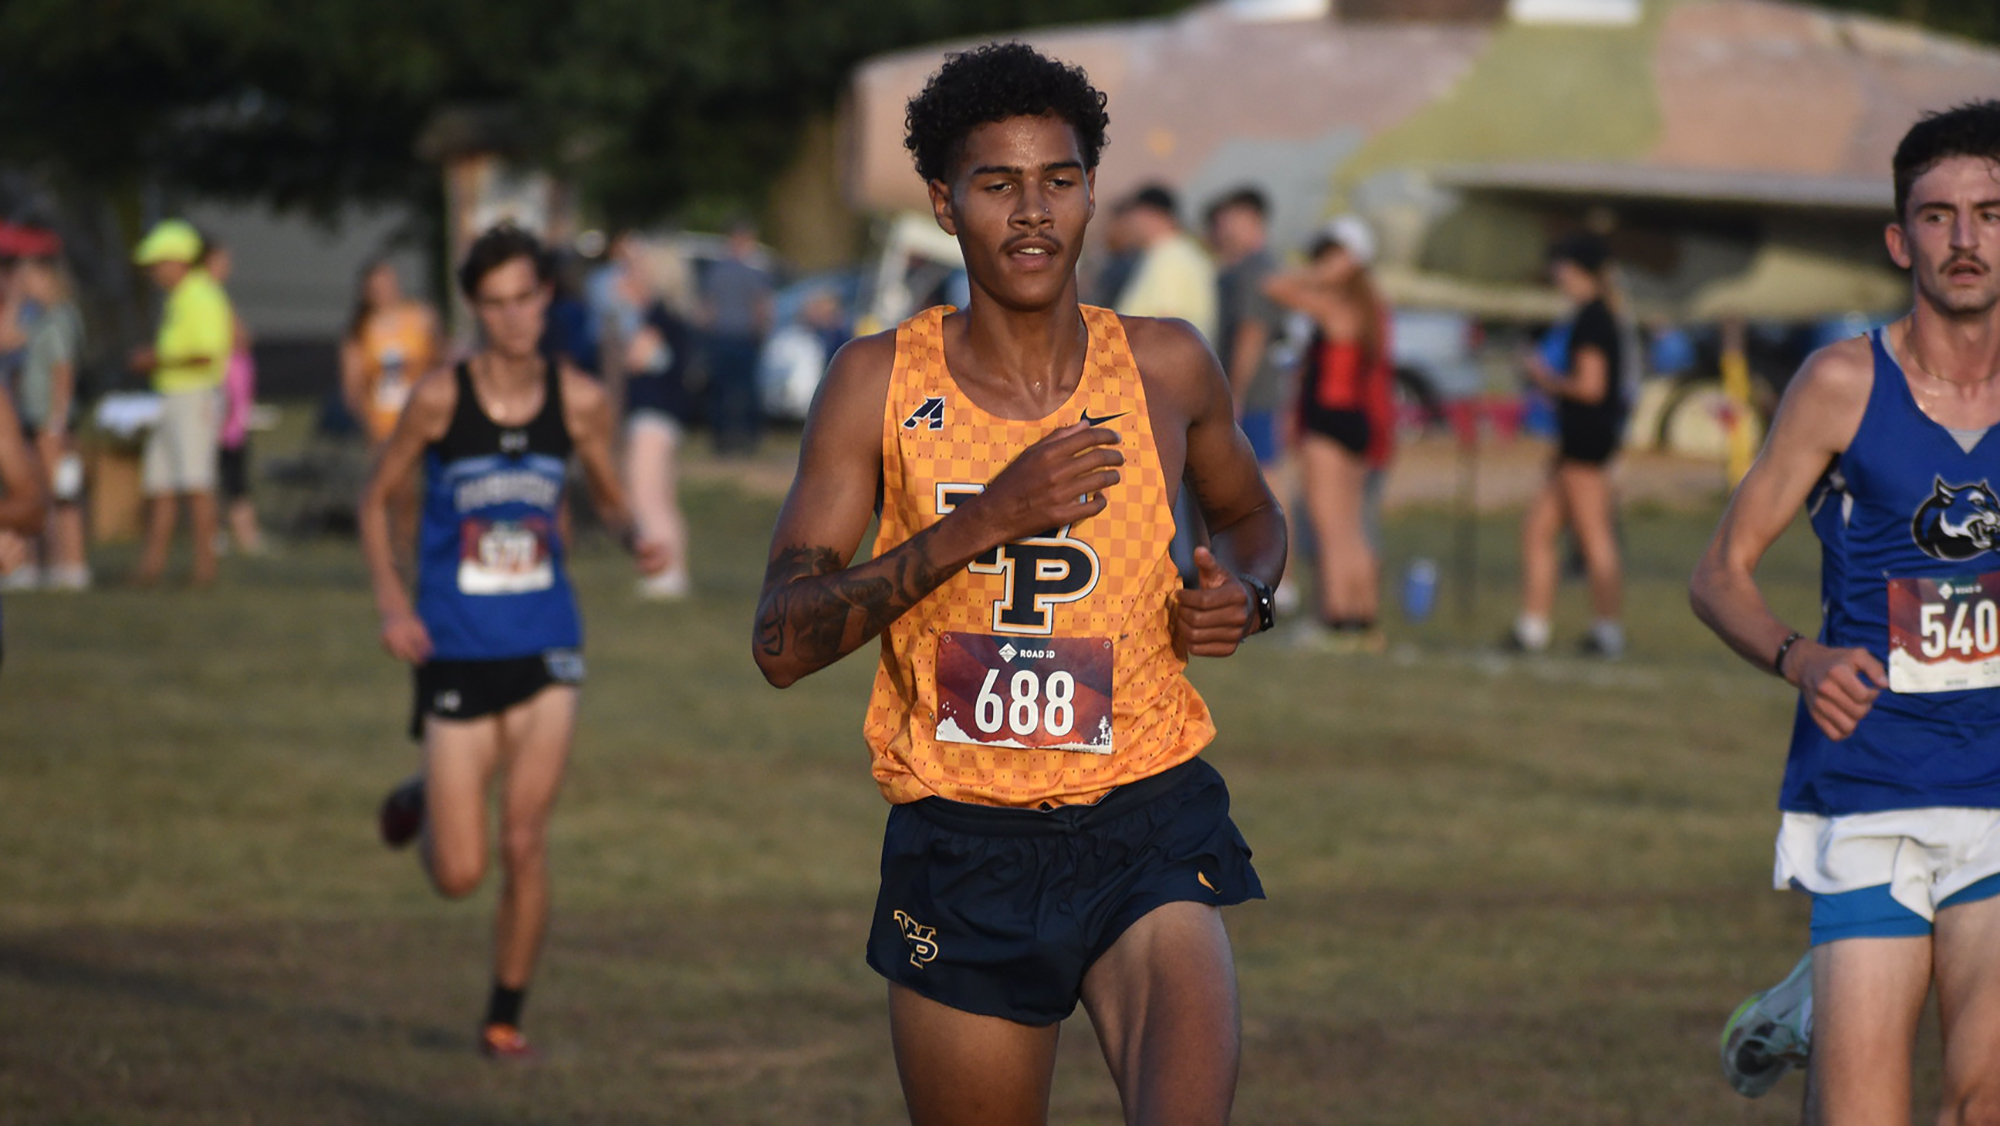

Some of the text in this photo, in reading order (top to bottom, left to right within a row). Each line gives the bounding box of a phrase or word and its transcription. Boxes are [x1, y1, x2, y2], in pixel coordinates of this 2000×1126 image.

[1020, 649, 1045, 659] ROAD
[1920, 600, 1998, 658] 540
[974, 668, 1075, 736] 688
